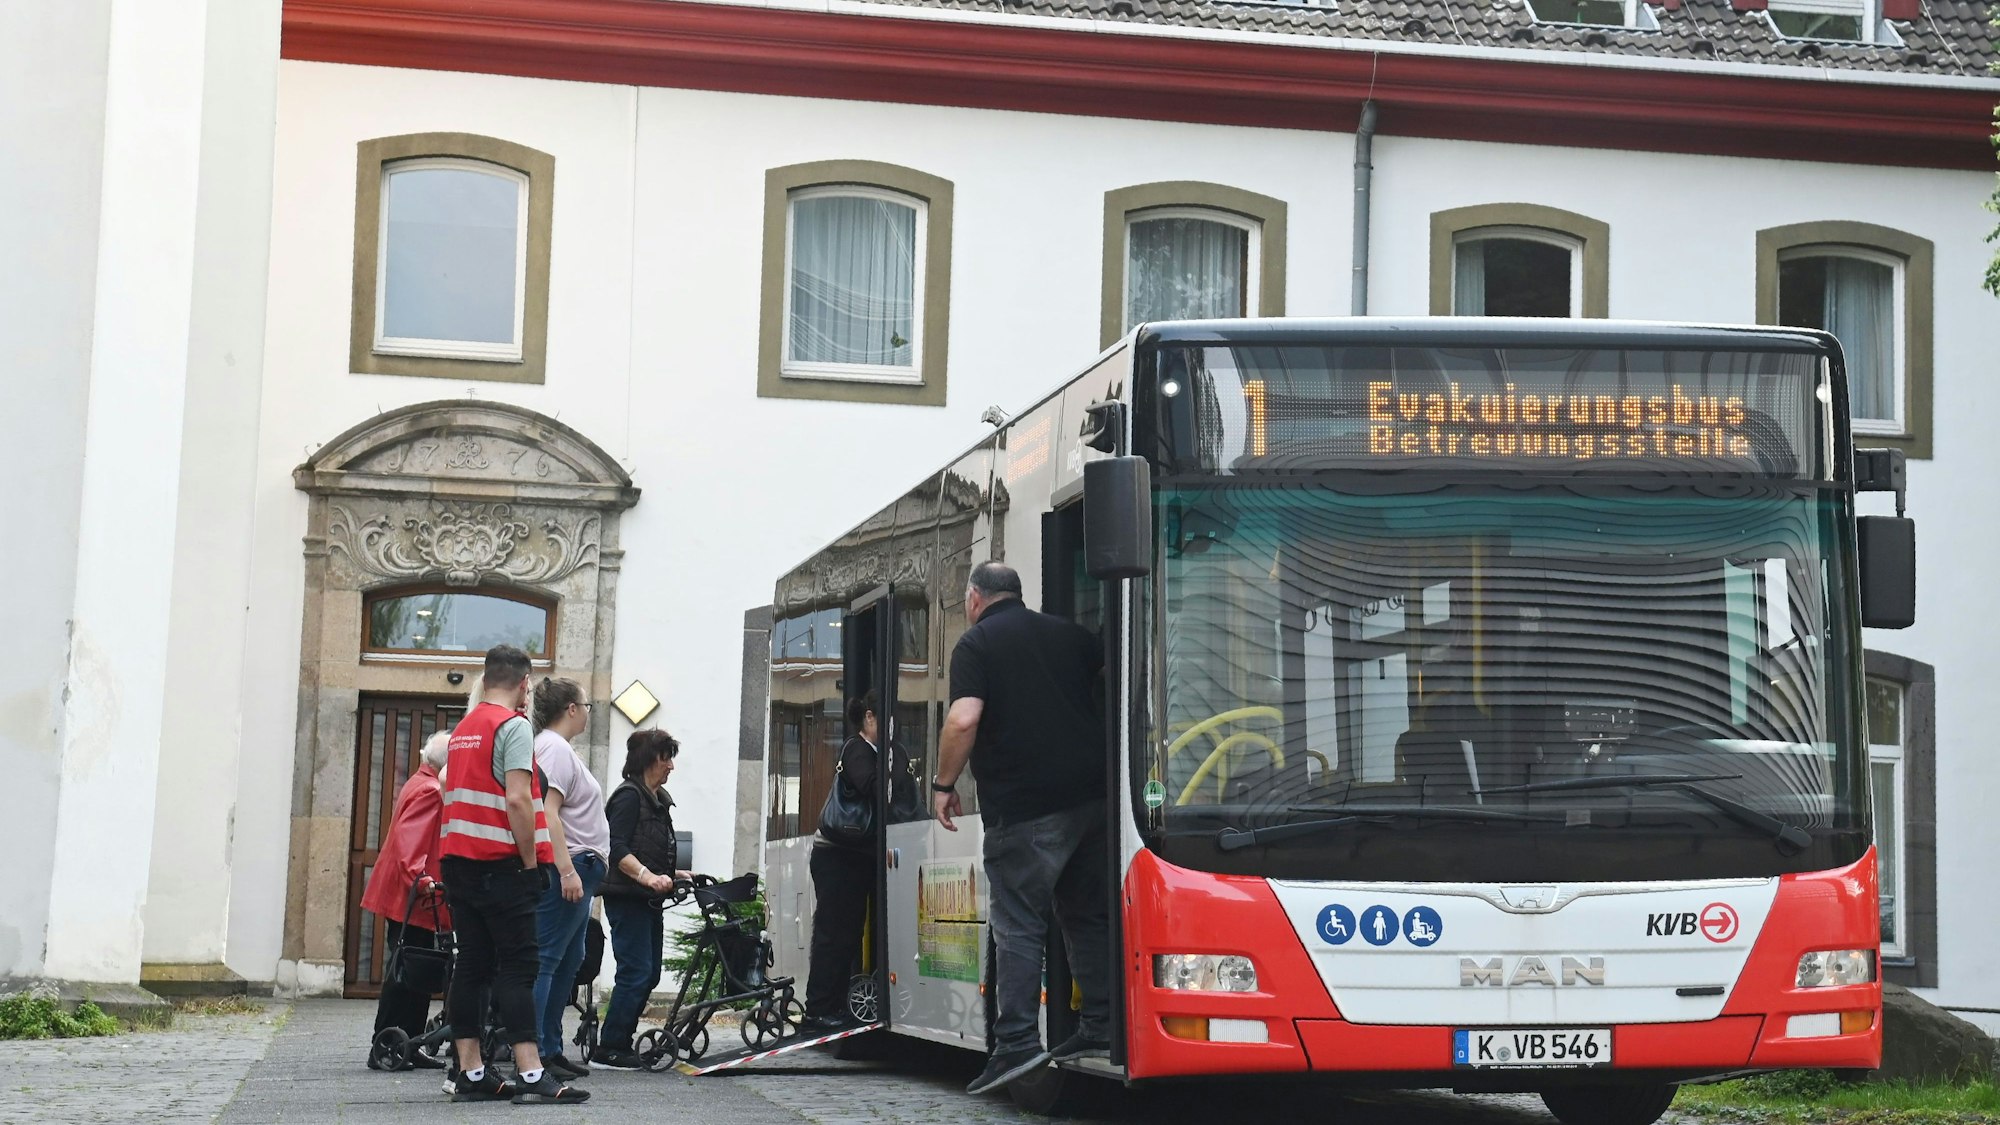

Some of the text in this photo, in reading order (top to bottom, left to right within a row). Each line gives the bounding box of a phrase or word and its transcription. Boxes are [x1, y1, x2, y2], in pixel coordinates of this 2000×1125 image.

[1244, 380, 1265, 456] 1
[1369, 381, 1745, 427] Evakuierungsbus
[1370, 424, 1749, 458] Betreuungsstelle
[1646, 911, 1697, 936] KVB
[1460, 956, 1605, 986] MAN
[1478, 1033, 1599, 1060] K VB 546
